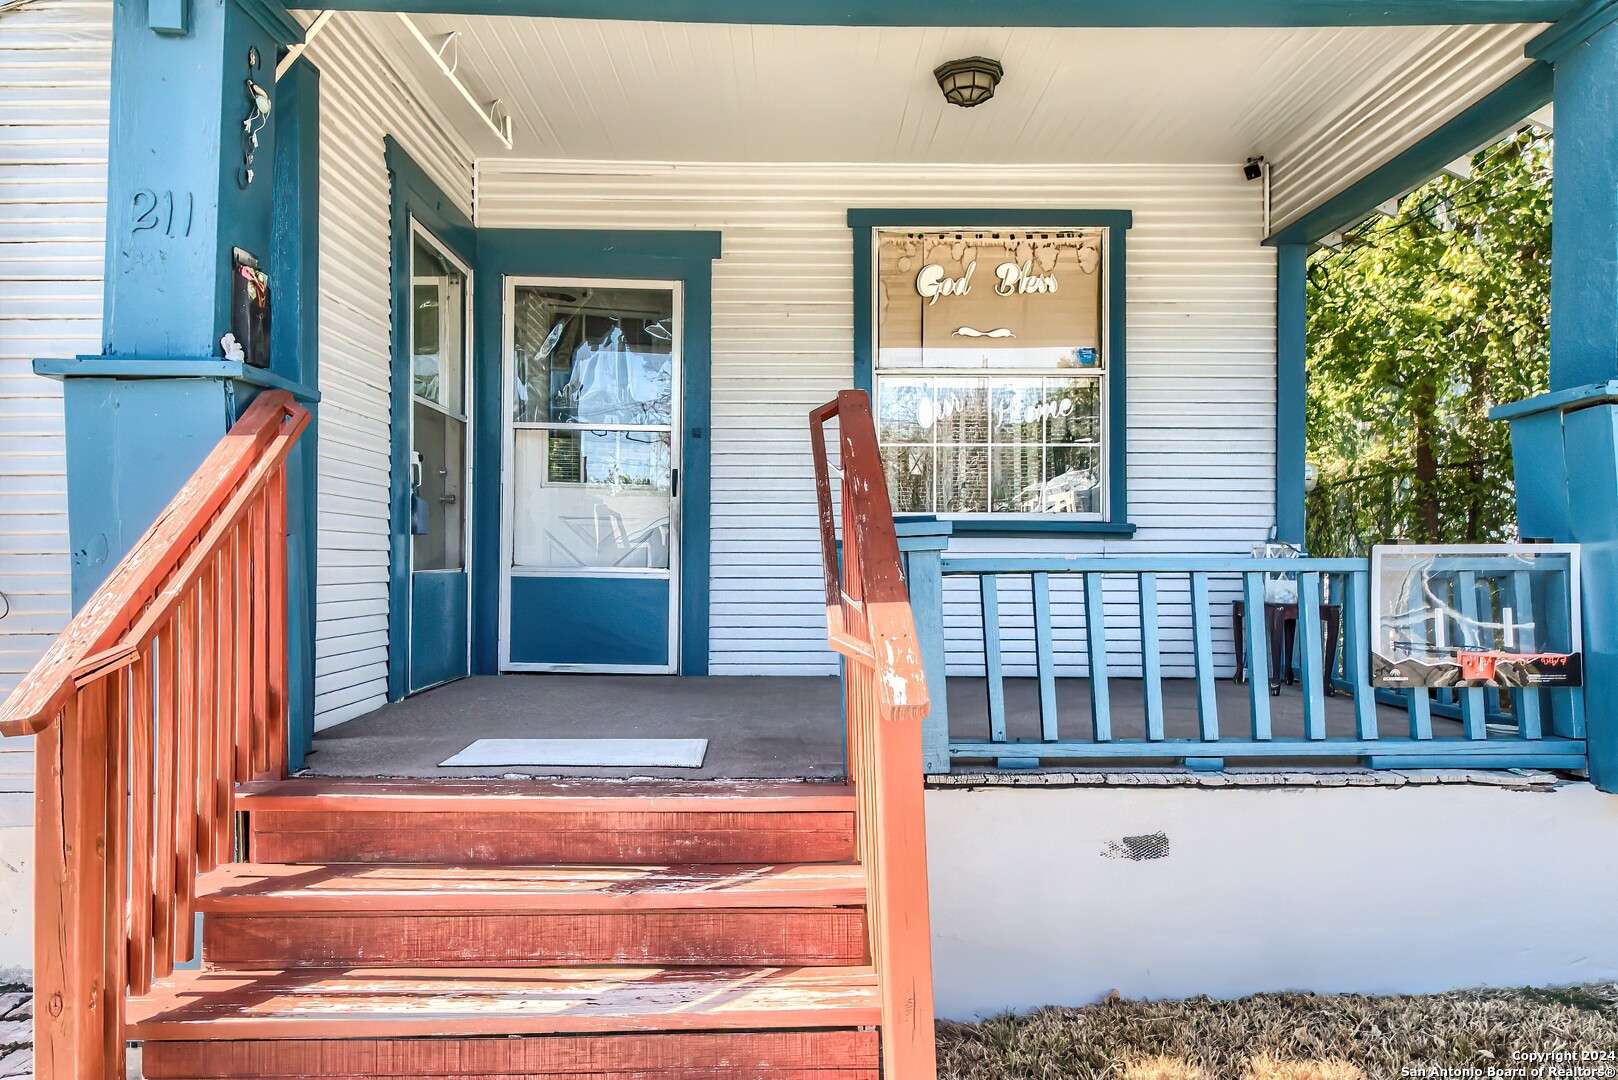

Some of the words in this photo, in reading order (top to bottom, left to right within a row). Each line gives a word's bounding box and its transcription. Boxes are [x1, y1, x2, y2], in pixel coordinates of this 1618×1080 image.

[131, 188, 193, 238] 211
[916, 260, 977, 306] God
[995, 259, 1058, 297] Bless
[917, 391, 964, 429] Our
[995, 391, 1074, 433] Home
